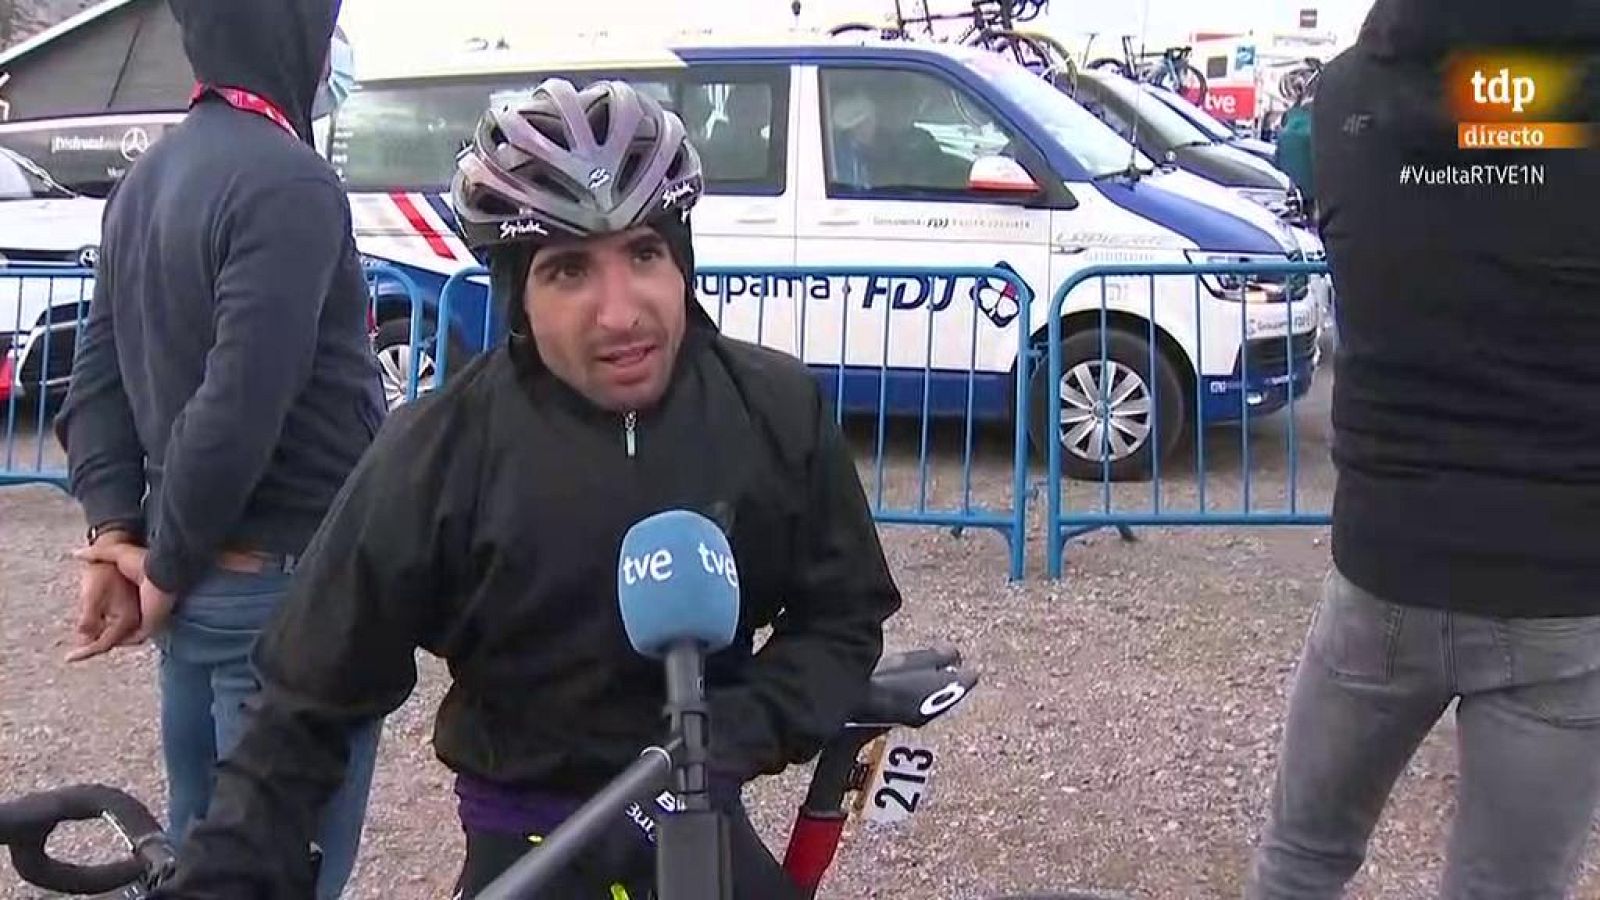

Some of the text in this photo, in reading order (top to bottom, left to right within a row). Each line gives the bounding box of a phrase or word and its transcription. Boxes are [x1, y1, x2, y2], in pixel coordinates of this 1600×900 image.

[1205, 93, 1237, 114] tve
[862, 272, 955, 312] FDJ
[623, 549, 672, 585] tve
[698, 542, 738, 587] tve
[874, 746, 934, 813] 213
